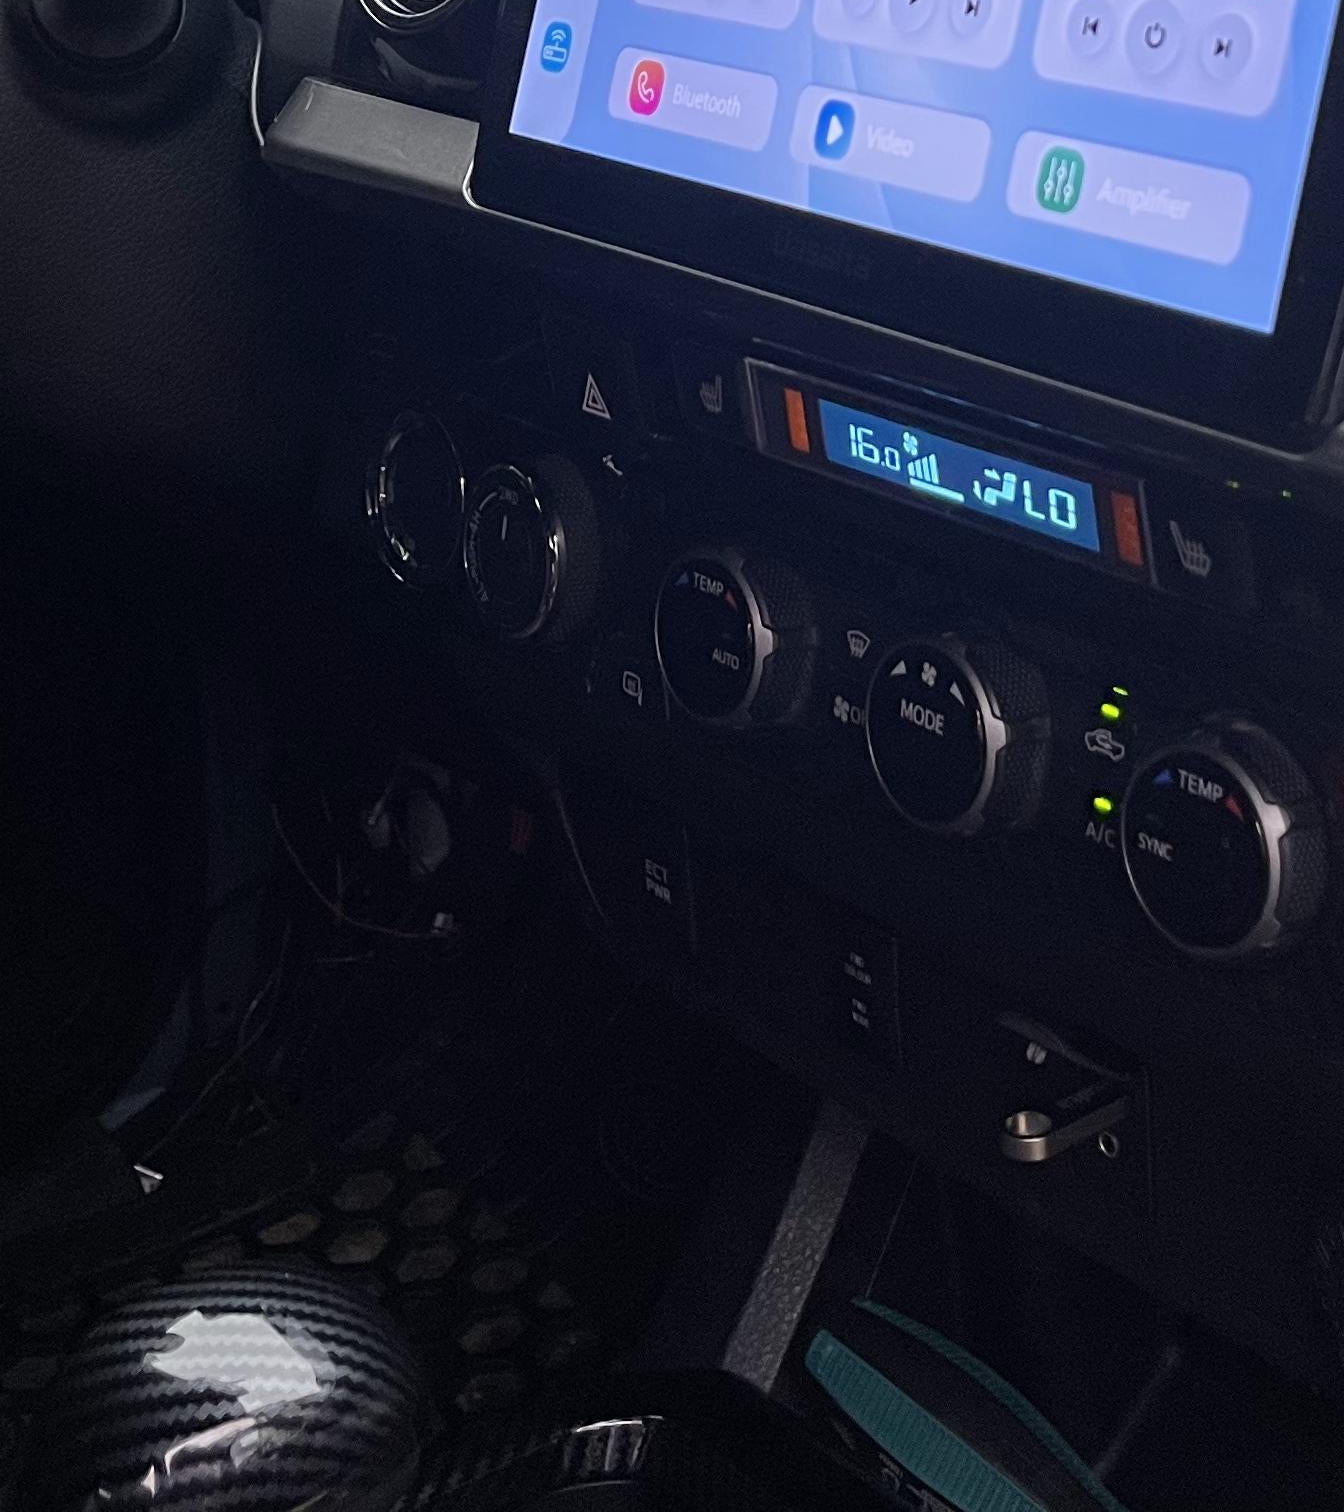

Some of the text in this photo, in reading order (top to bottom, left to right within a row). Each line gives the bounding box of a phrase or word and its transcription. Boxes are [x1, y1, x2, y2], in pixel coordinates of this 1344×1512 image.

[672, 83, 742, 118] Bluetooth
[867, 124, 914, 158] Video
[1096, 176, 1193, 221] Amplifier
[849, 423, 901, 472] 16.0
[1022, 479, 1078, 530] LO
[693, 571, 725, 597] TEMP
[711, 648, 740, 670] AUTO
[900, 697, 945, 737] MODE
[1177, 768, 1224, 803] TEMP
[1085, 821, 1116, 849] A/C
[1136, 831, 1174, 862] SYNC
